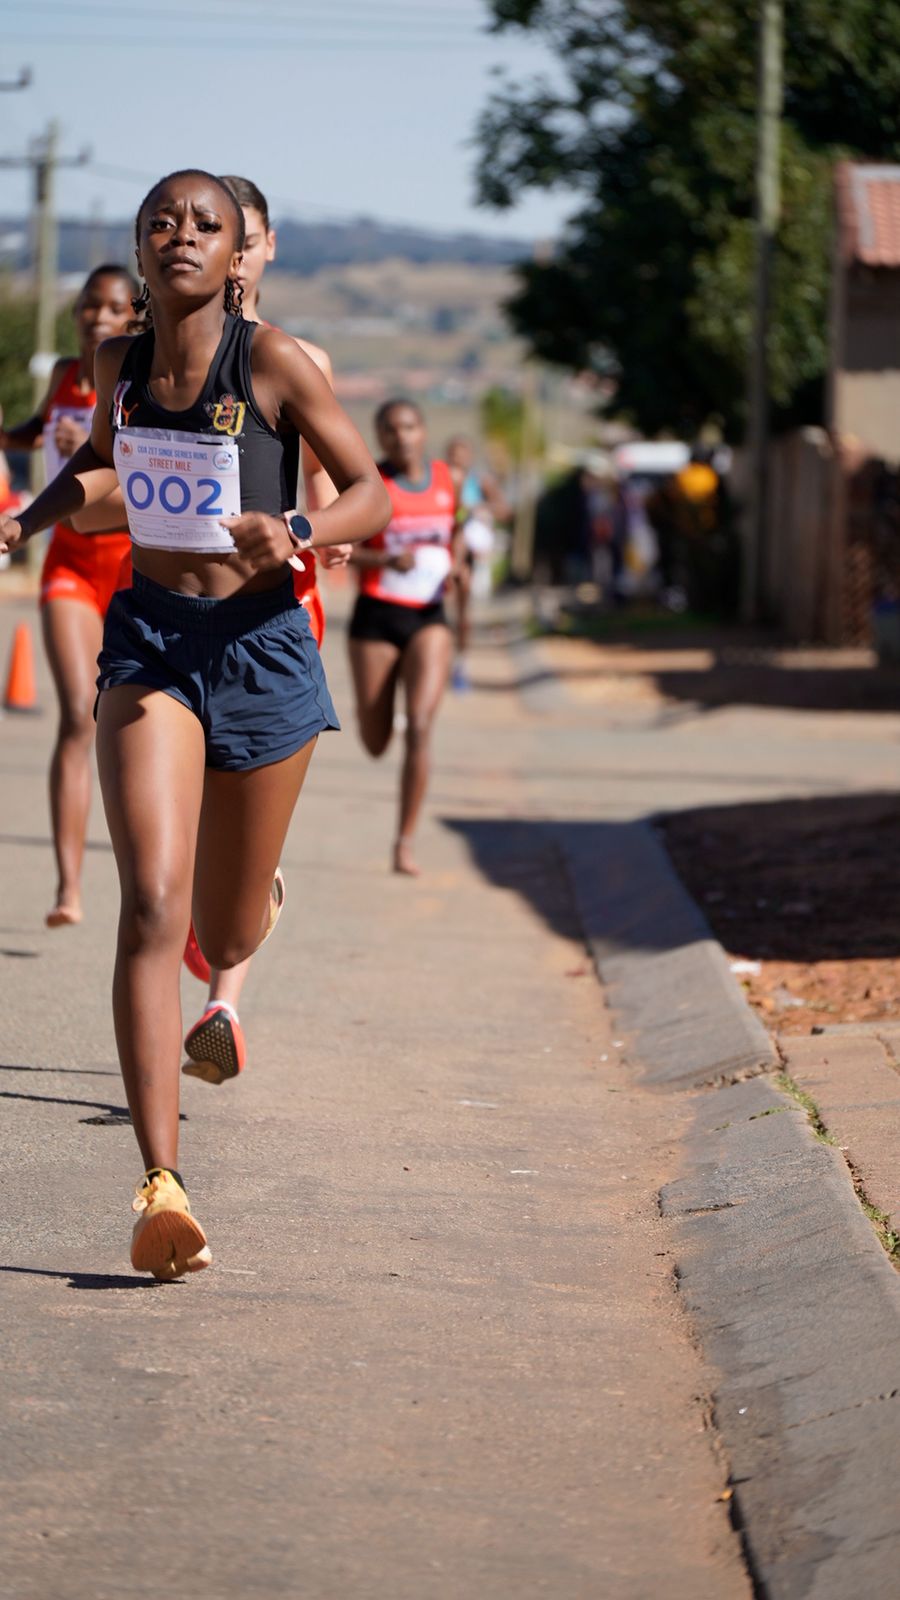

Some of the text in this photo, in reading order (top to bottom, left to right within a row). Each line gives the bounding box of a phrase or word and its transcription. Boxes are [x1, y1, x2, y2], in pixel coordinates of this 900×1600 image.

[174, 449, 193, 459] SERIES
[193, 451, 208, 461] RUNS
[149, 457, 192, 472] STREET MILE
[127, 471, 223, 515] 002
